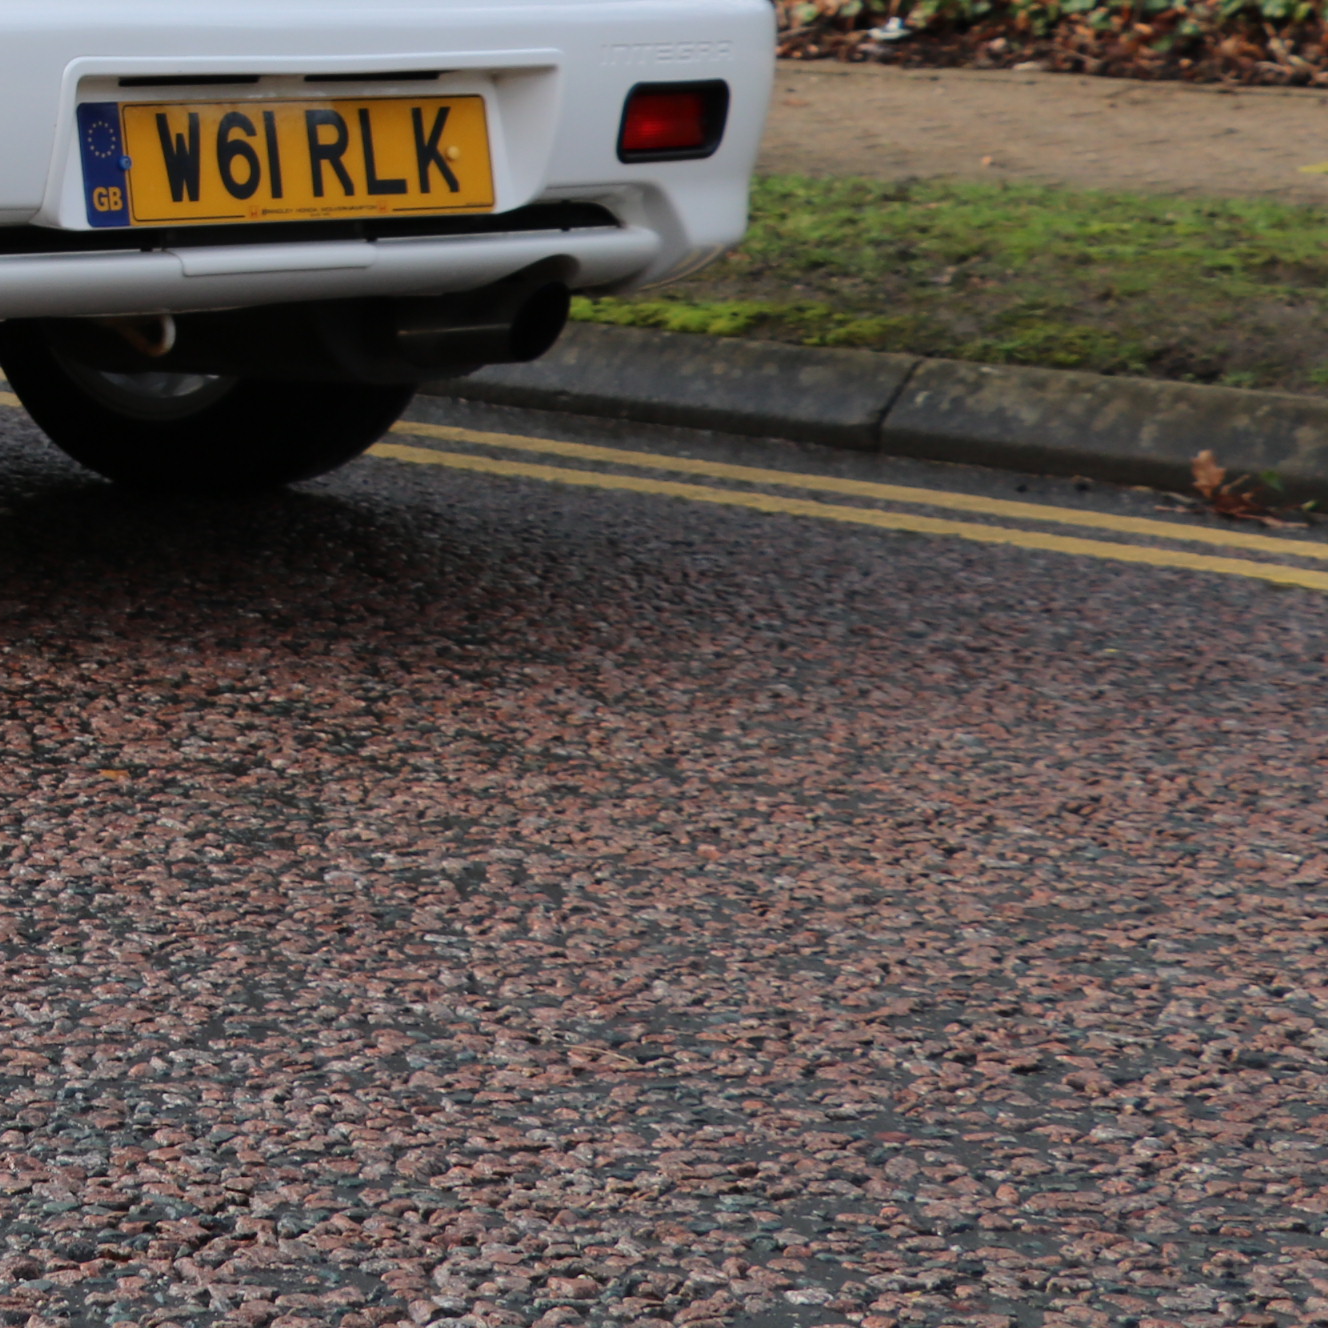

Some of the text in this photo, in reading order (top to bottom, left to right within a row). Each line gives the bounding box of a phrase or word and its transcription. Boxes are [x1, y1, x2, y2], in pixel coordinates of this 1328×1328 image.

[155, 106, 461, 203] W61 RLK
[92, 186, 123, 214] GB
